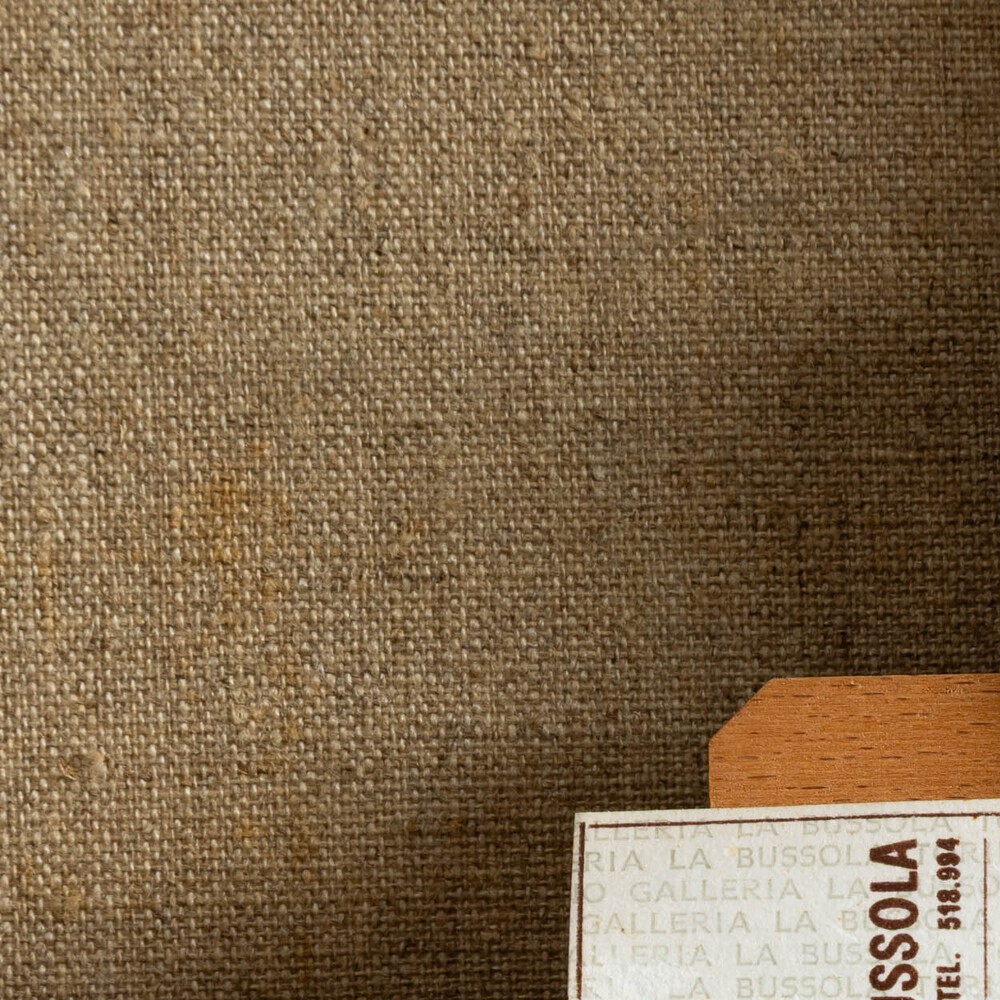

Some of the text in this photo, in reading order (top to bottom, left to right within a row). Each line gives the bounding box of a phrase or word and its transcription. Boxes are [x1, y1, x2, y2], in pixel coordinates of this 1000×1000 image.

[670, 848, 712, 870] LA
[629, 878, 803, 903] GALLERIA
[828, 875, 870, 899] LA
[936, 837, 962, 930] 518.994
[775, 909, 818, 933] LA
[735, 943, 778, 966] LA
